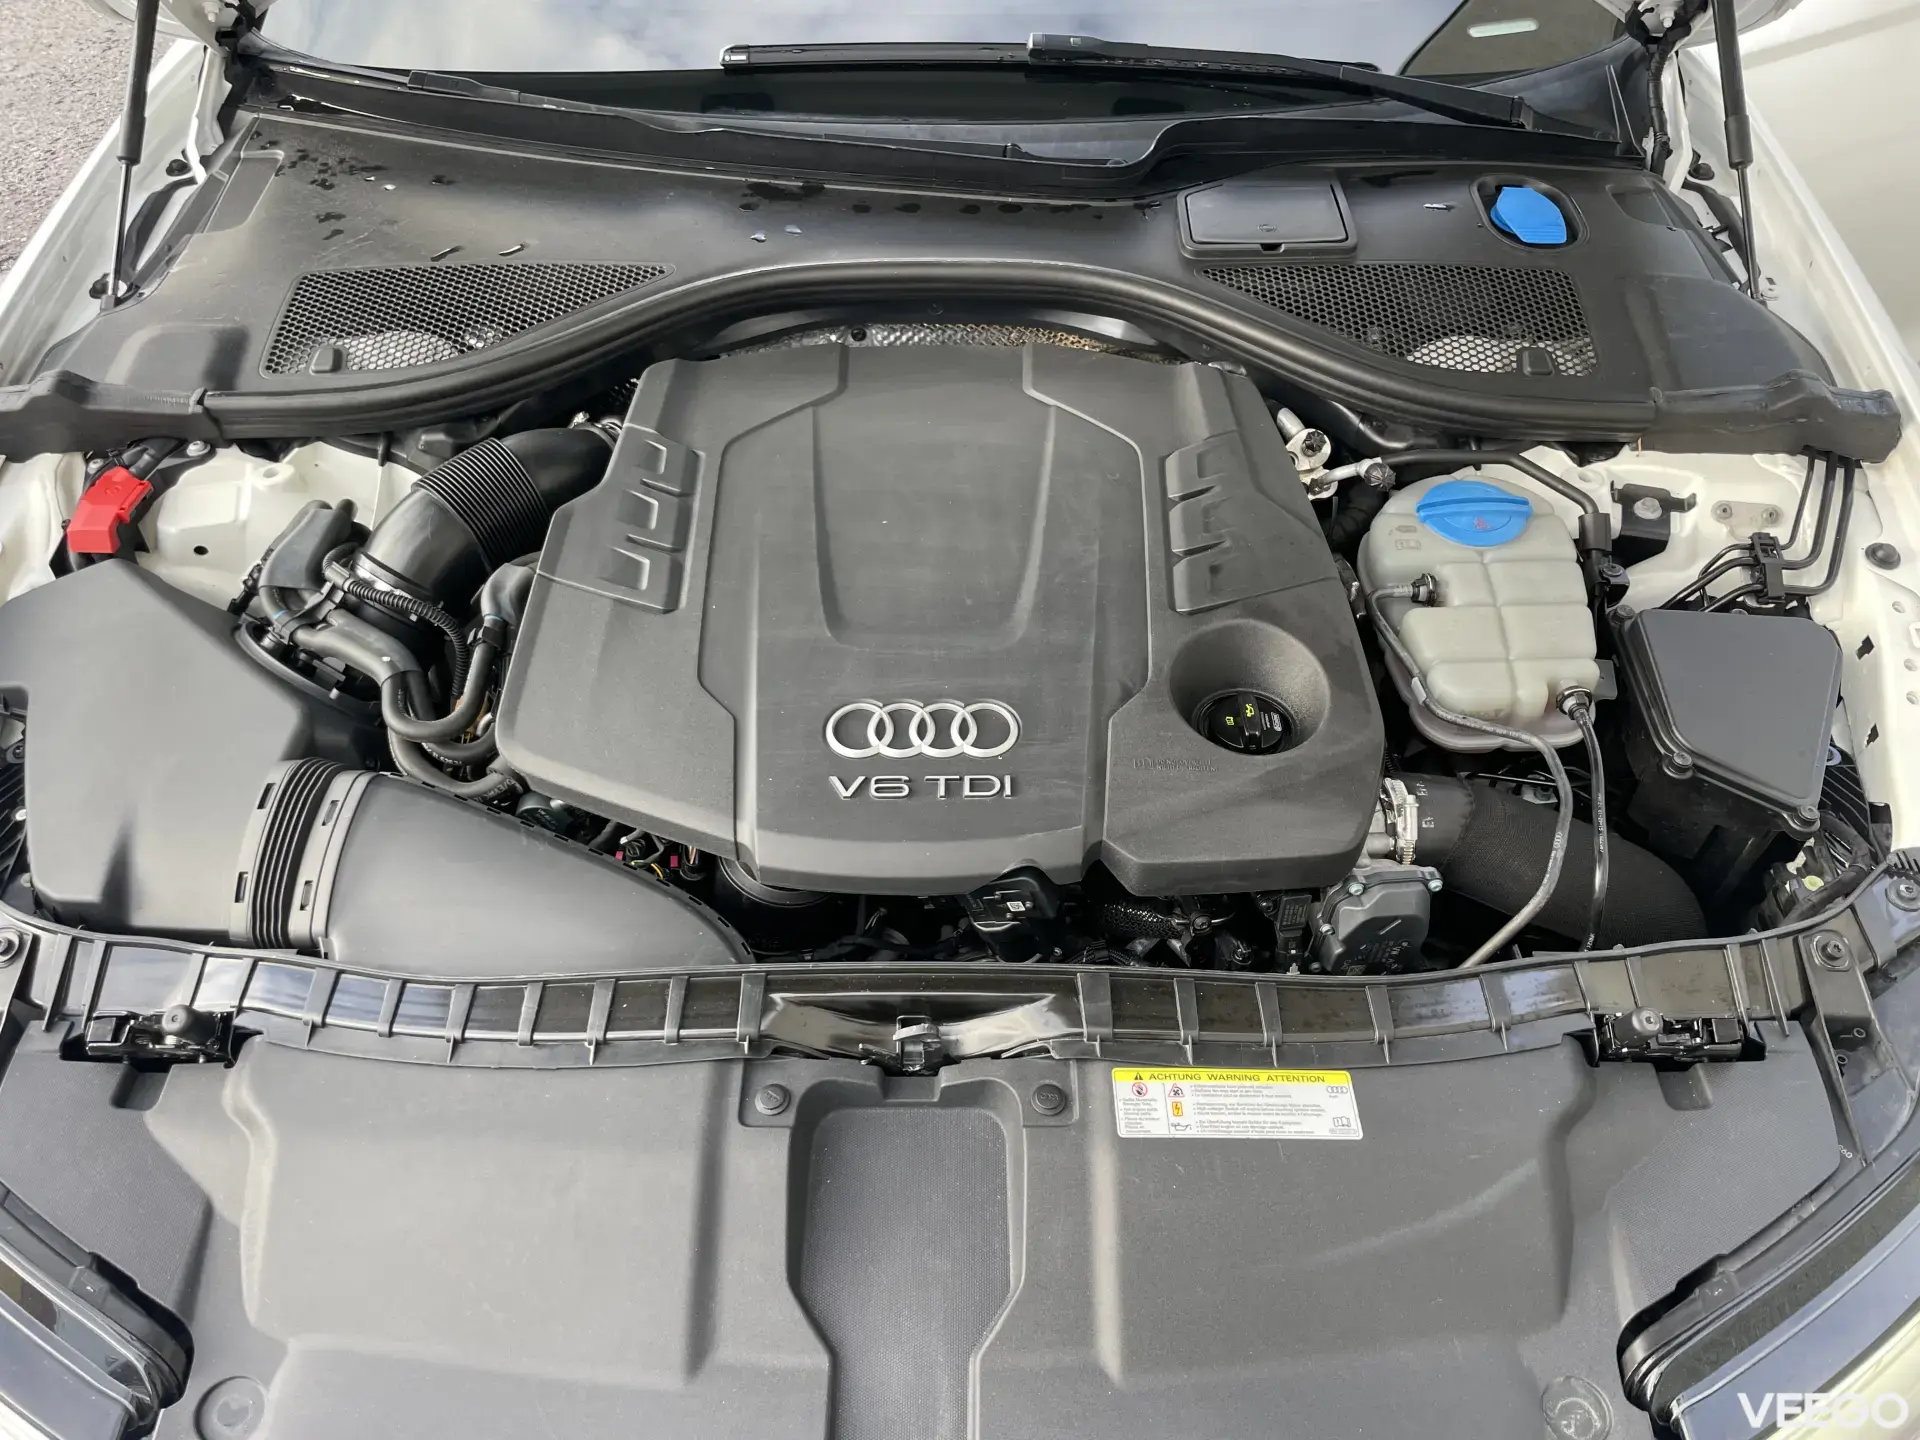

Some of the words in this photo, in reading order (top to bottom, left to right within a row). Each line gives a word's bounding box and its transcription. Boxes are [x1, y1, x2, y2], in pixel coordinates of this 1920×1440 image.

[828, 775, 910, 800] V6
[924, 775, 1012, 799] TDI
[1149, 1073, 1201, 1081] ACHTUNG
[1207, 1074, 1260, 1082] WARNING
[1266, 1075, 1325, 1083] ATTENTION
